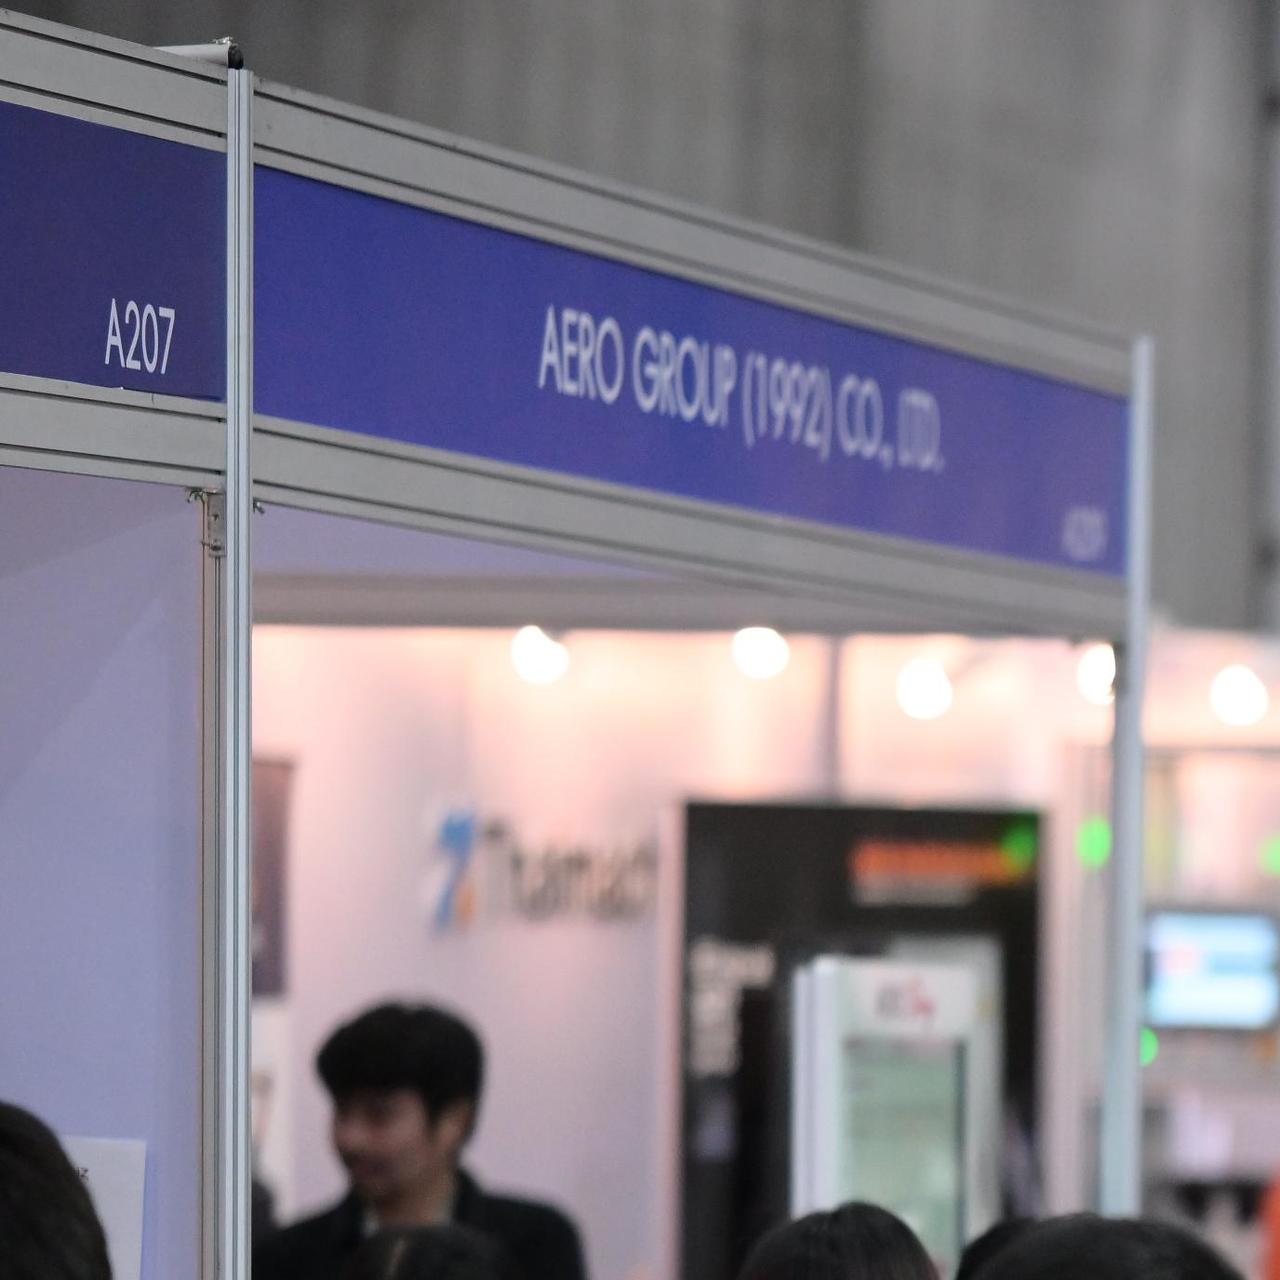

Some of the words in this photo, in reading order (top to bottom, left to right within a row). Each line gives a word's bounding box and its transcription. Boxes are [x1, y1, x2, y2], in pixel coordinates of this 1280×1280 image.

[104, 297, 176, 375] A207
[538, 303, 625, 405] AERO
[632, 325, 738, 428] GROUP
[742, 351, 833, 463] (1992)
